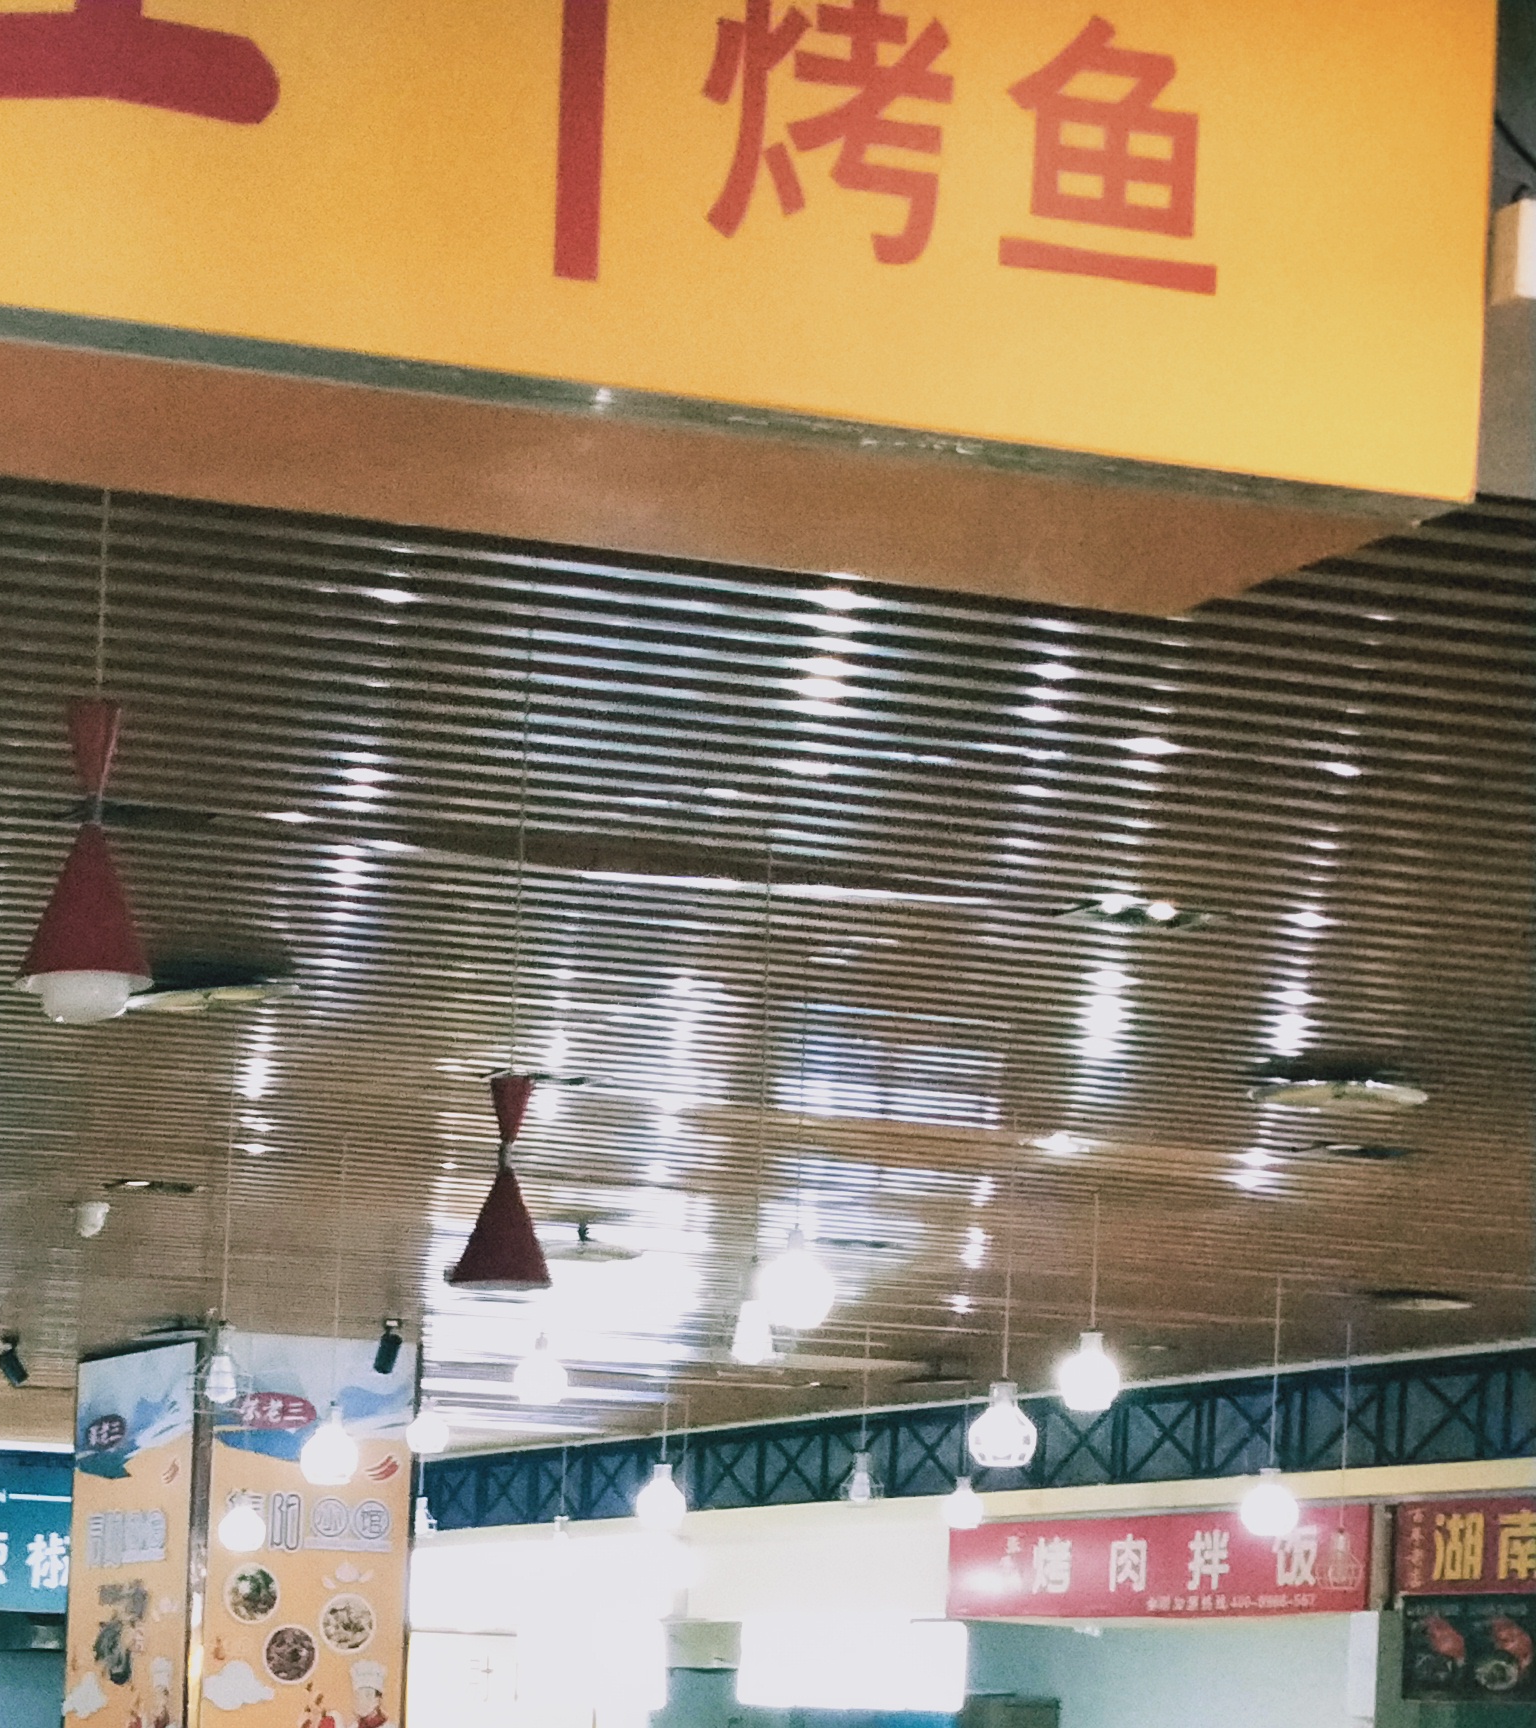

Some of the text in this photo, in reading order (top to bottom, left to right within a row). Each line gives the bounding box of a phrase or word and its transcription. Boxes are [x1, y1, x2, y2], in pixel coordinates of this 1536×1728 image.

[701, 0, 1217, 296] 烤鱼
[1032, 1524, 1319, 1595] 烤肉拌饭
[1432, 1507, 1536, 1581] 湖南
